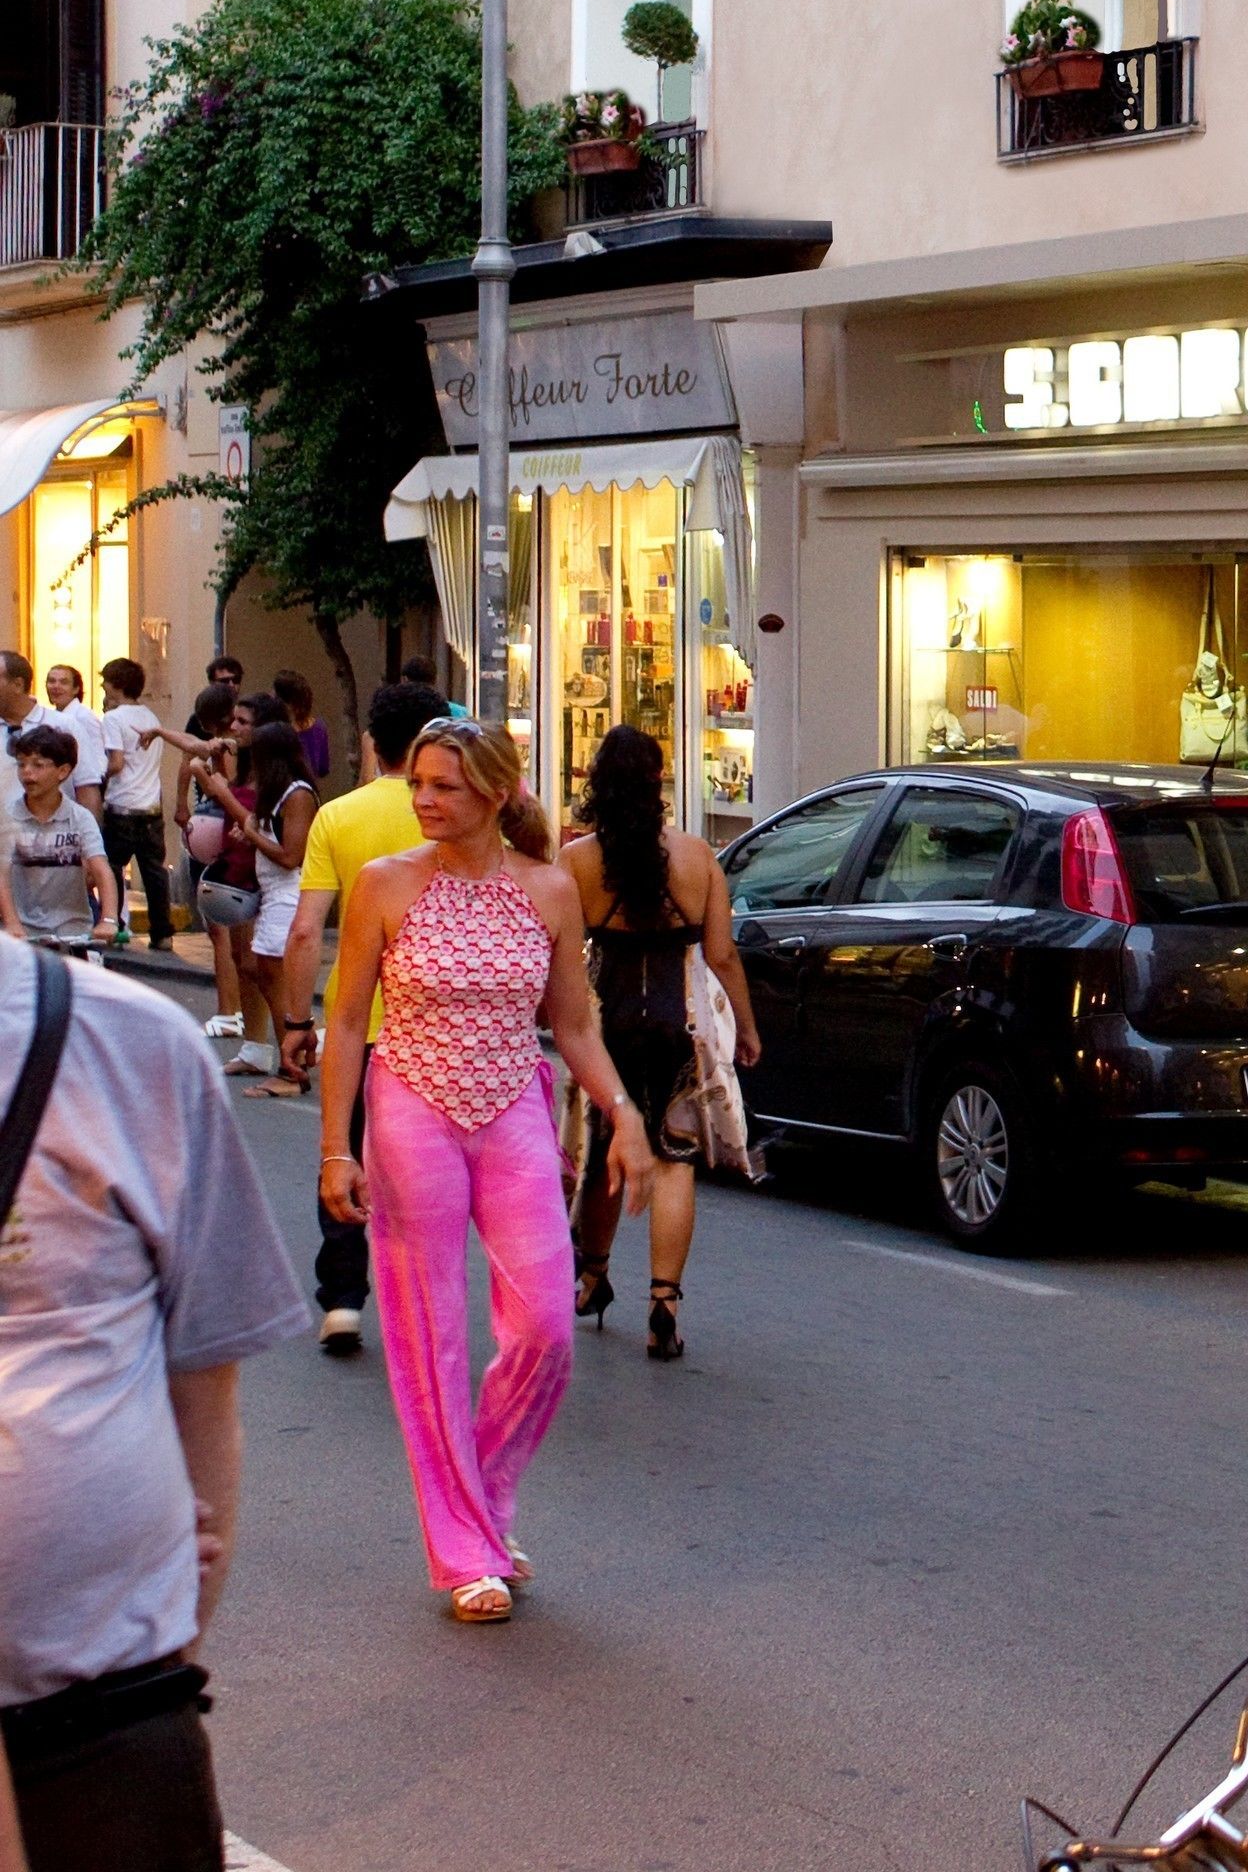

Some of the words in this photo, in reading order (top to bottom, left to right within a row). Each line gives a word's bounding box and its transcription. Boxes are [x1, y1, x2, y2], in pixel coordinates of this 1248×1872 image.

[445, 364, 588, 428] Cffeur
[593, 352, 698, 404] Forte
[522, 453, 583, 479] COIFFEUR
[967, 689, 997, 709] SALDI
